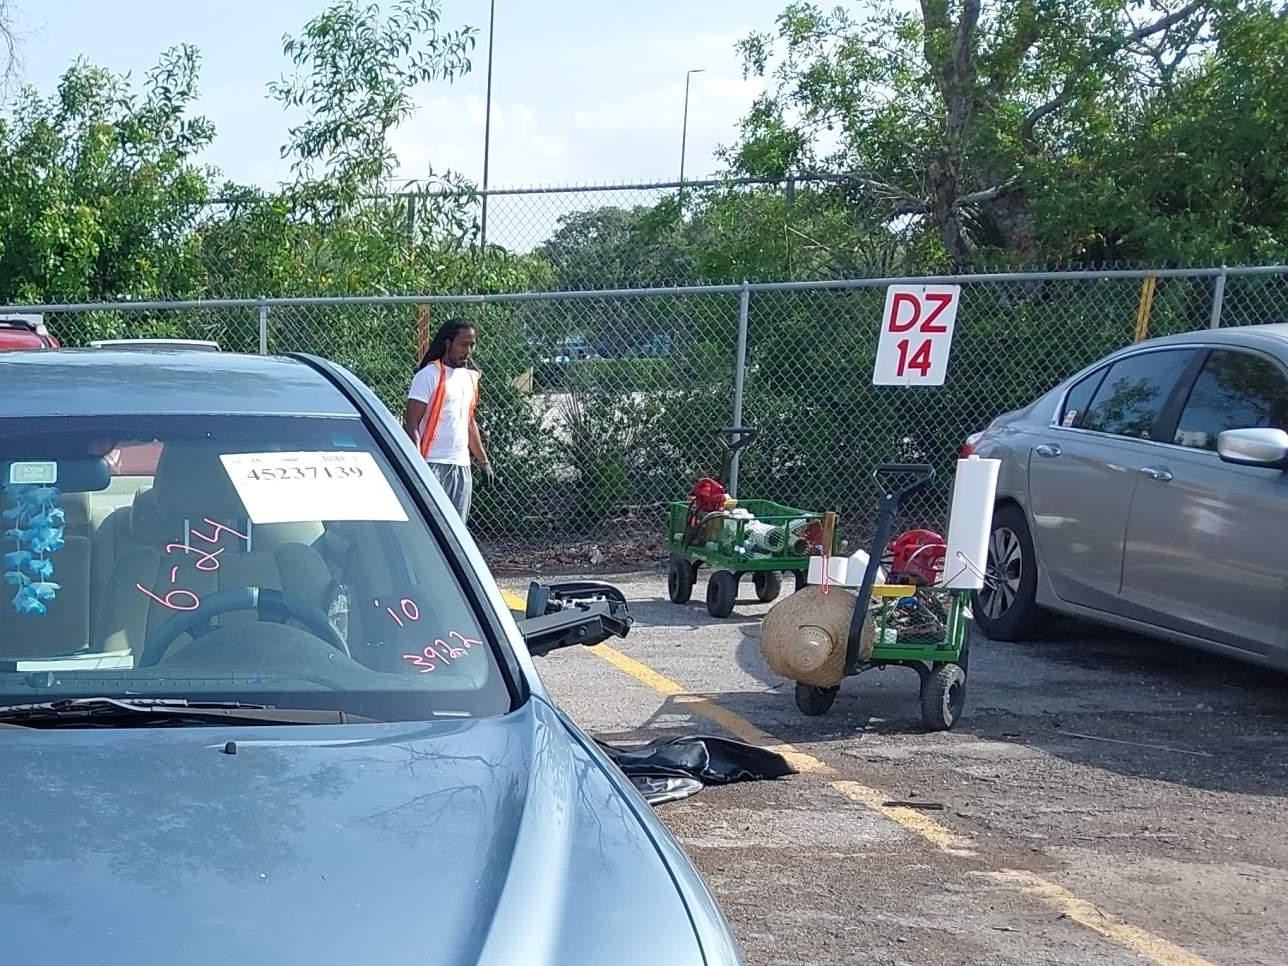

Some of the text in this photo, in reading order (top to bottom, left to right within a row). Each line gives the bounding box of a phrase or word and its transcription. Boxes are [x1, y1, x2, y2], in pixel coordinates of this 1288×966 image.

[888, 293, 953, 333] DZ
[896, 339, 933, 377] 14
[247, 466, 364, 481] 45237139
